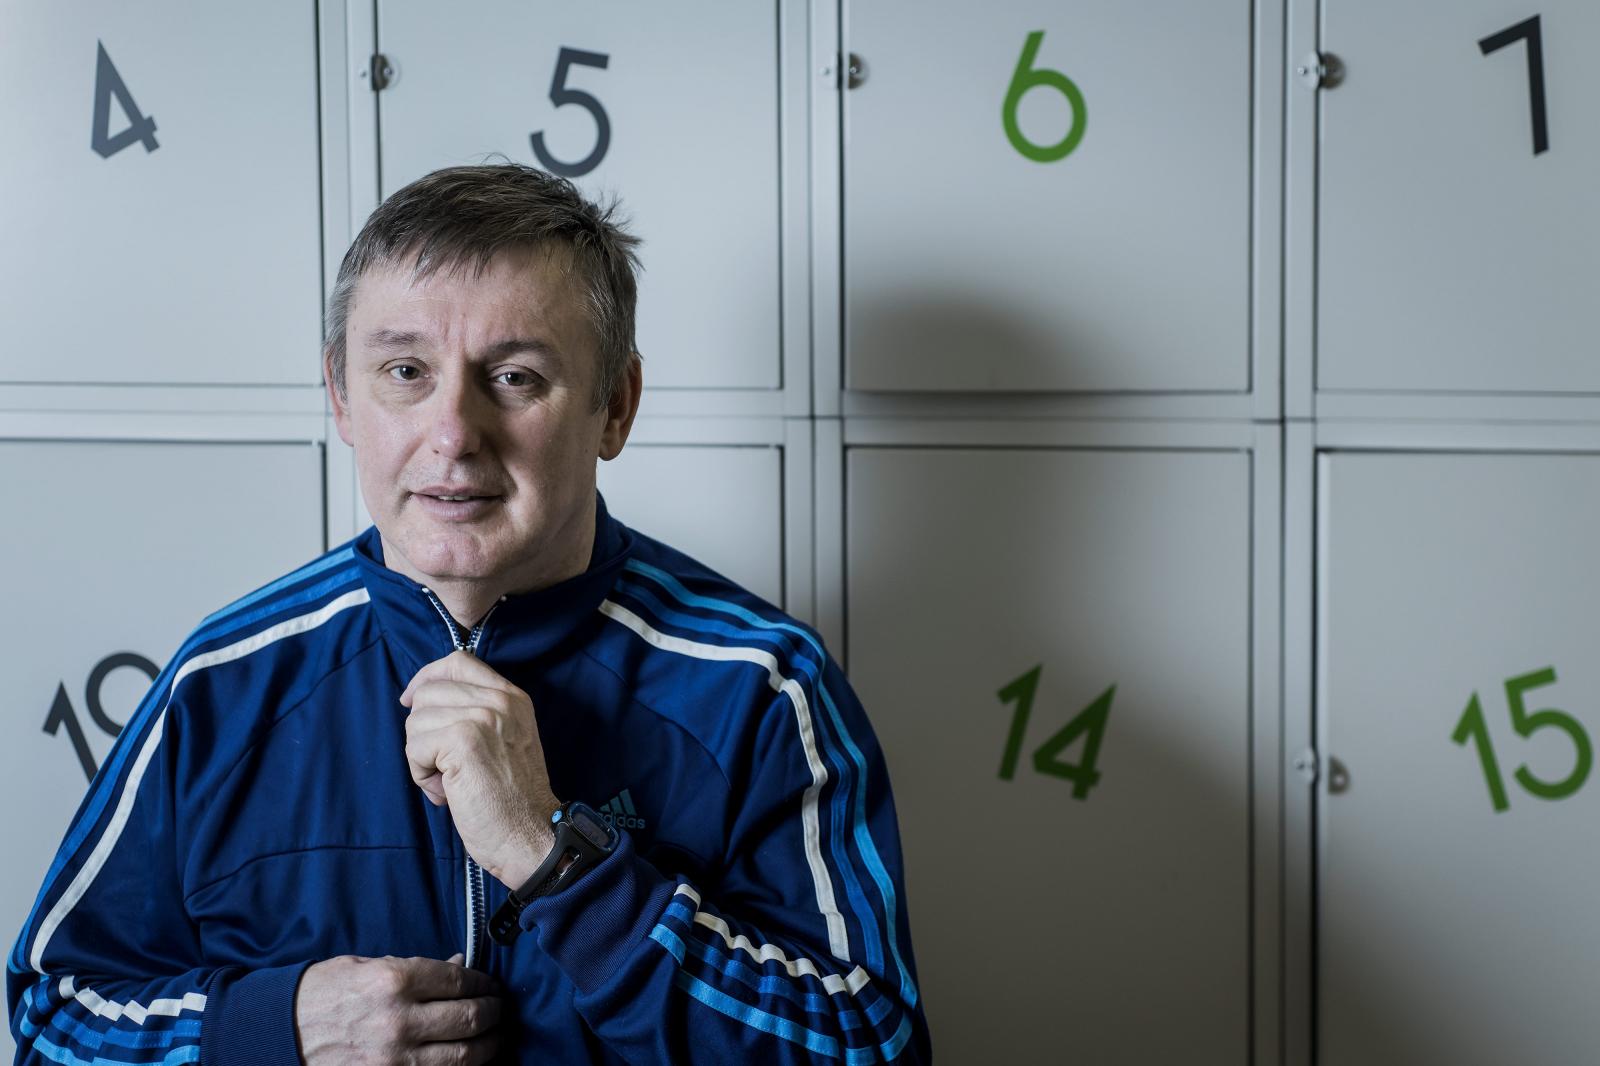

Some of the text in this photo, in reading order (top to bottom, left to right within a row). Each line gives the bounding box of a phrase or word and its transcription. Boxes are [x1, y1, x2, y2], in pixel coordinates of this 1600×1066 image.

[91, 40, 160, 159] 4
[530, 47, 611, 178] 5
[1002, 30, 1088, 164] 6
[997, 664, 1117, 801] 14
[1451, 666, 1593, 812] 15
